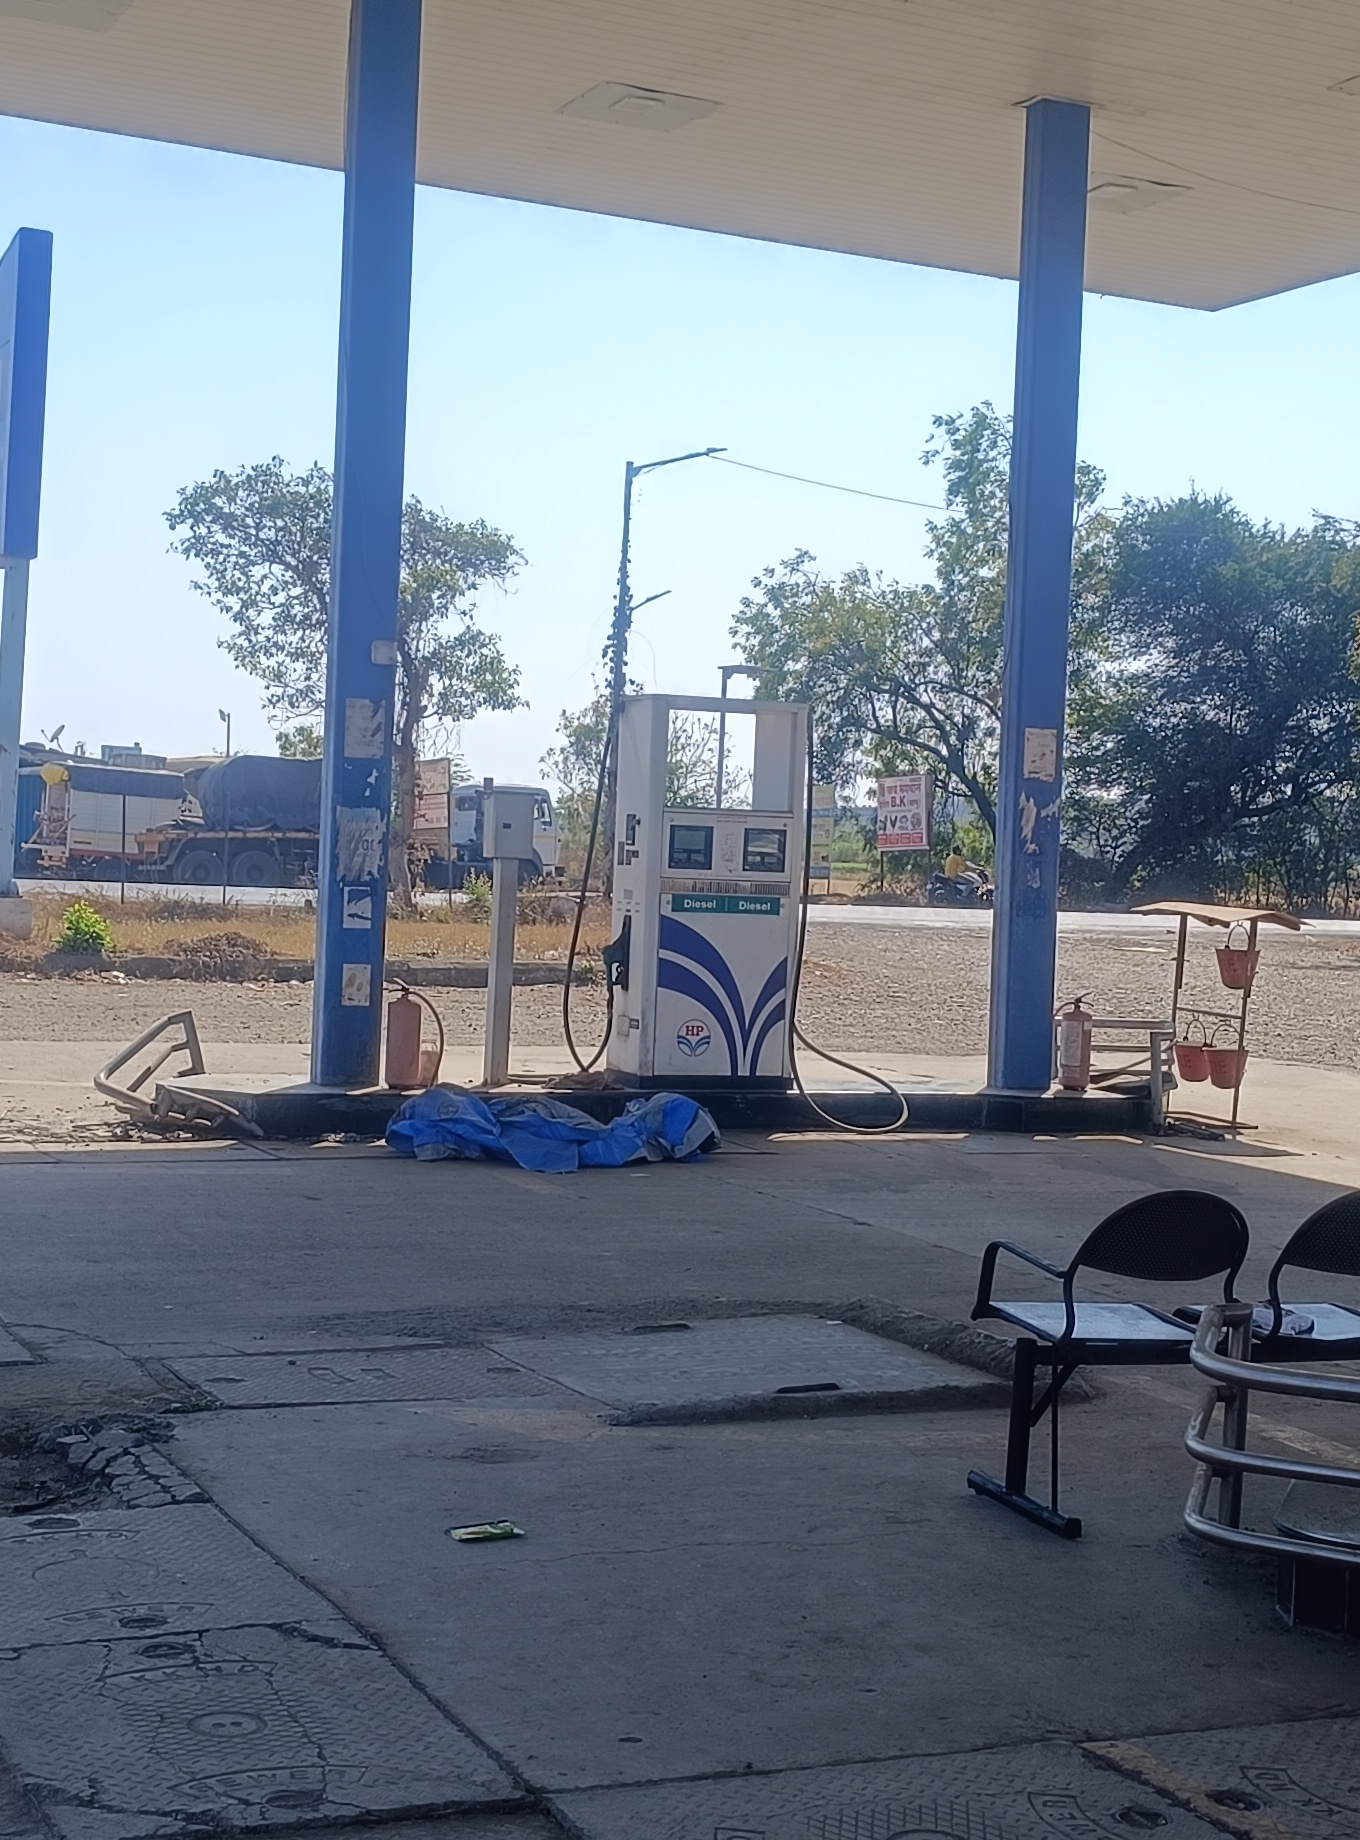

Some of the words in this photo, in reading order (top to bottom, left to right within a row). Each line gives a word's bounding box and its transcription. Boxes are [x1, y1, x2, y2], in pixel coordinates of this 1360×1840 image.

[891, 795, 907, 808] B.K
[684, 899, 716, 908] Diesel
[738, 901, 771, 911] Diesel
[685, 1025, 704, 1036] HP
[188, 1769, 347, 1792] SEWER
